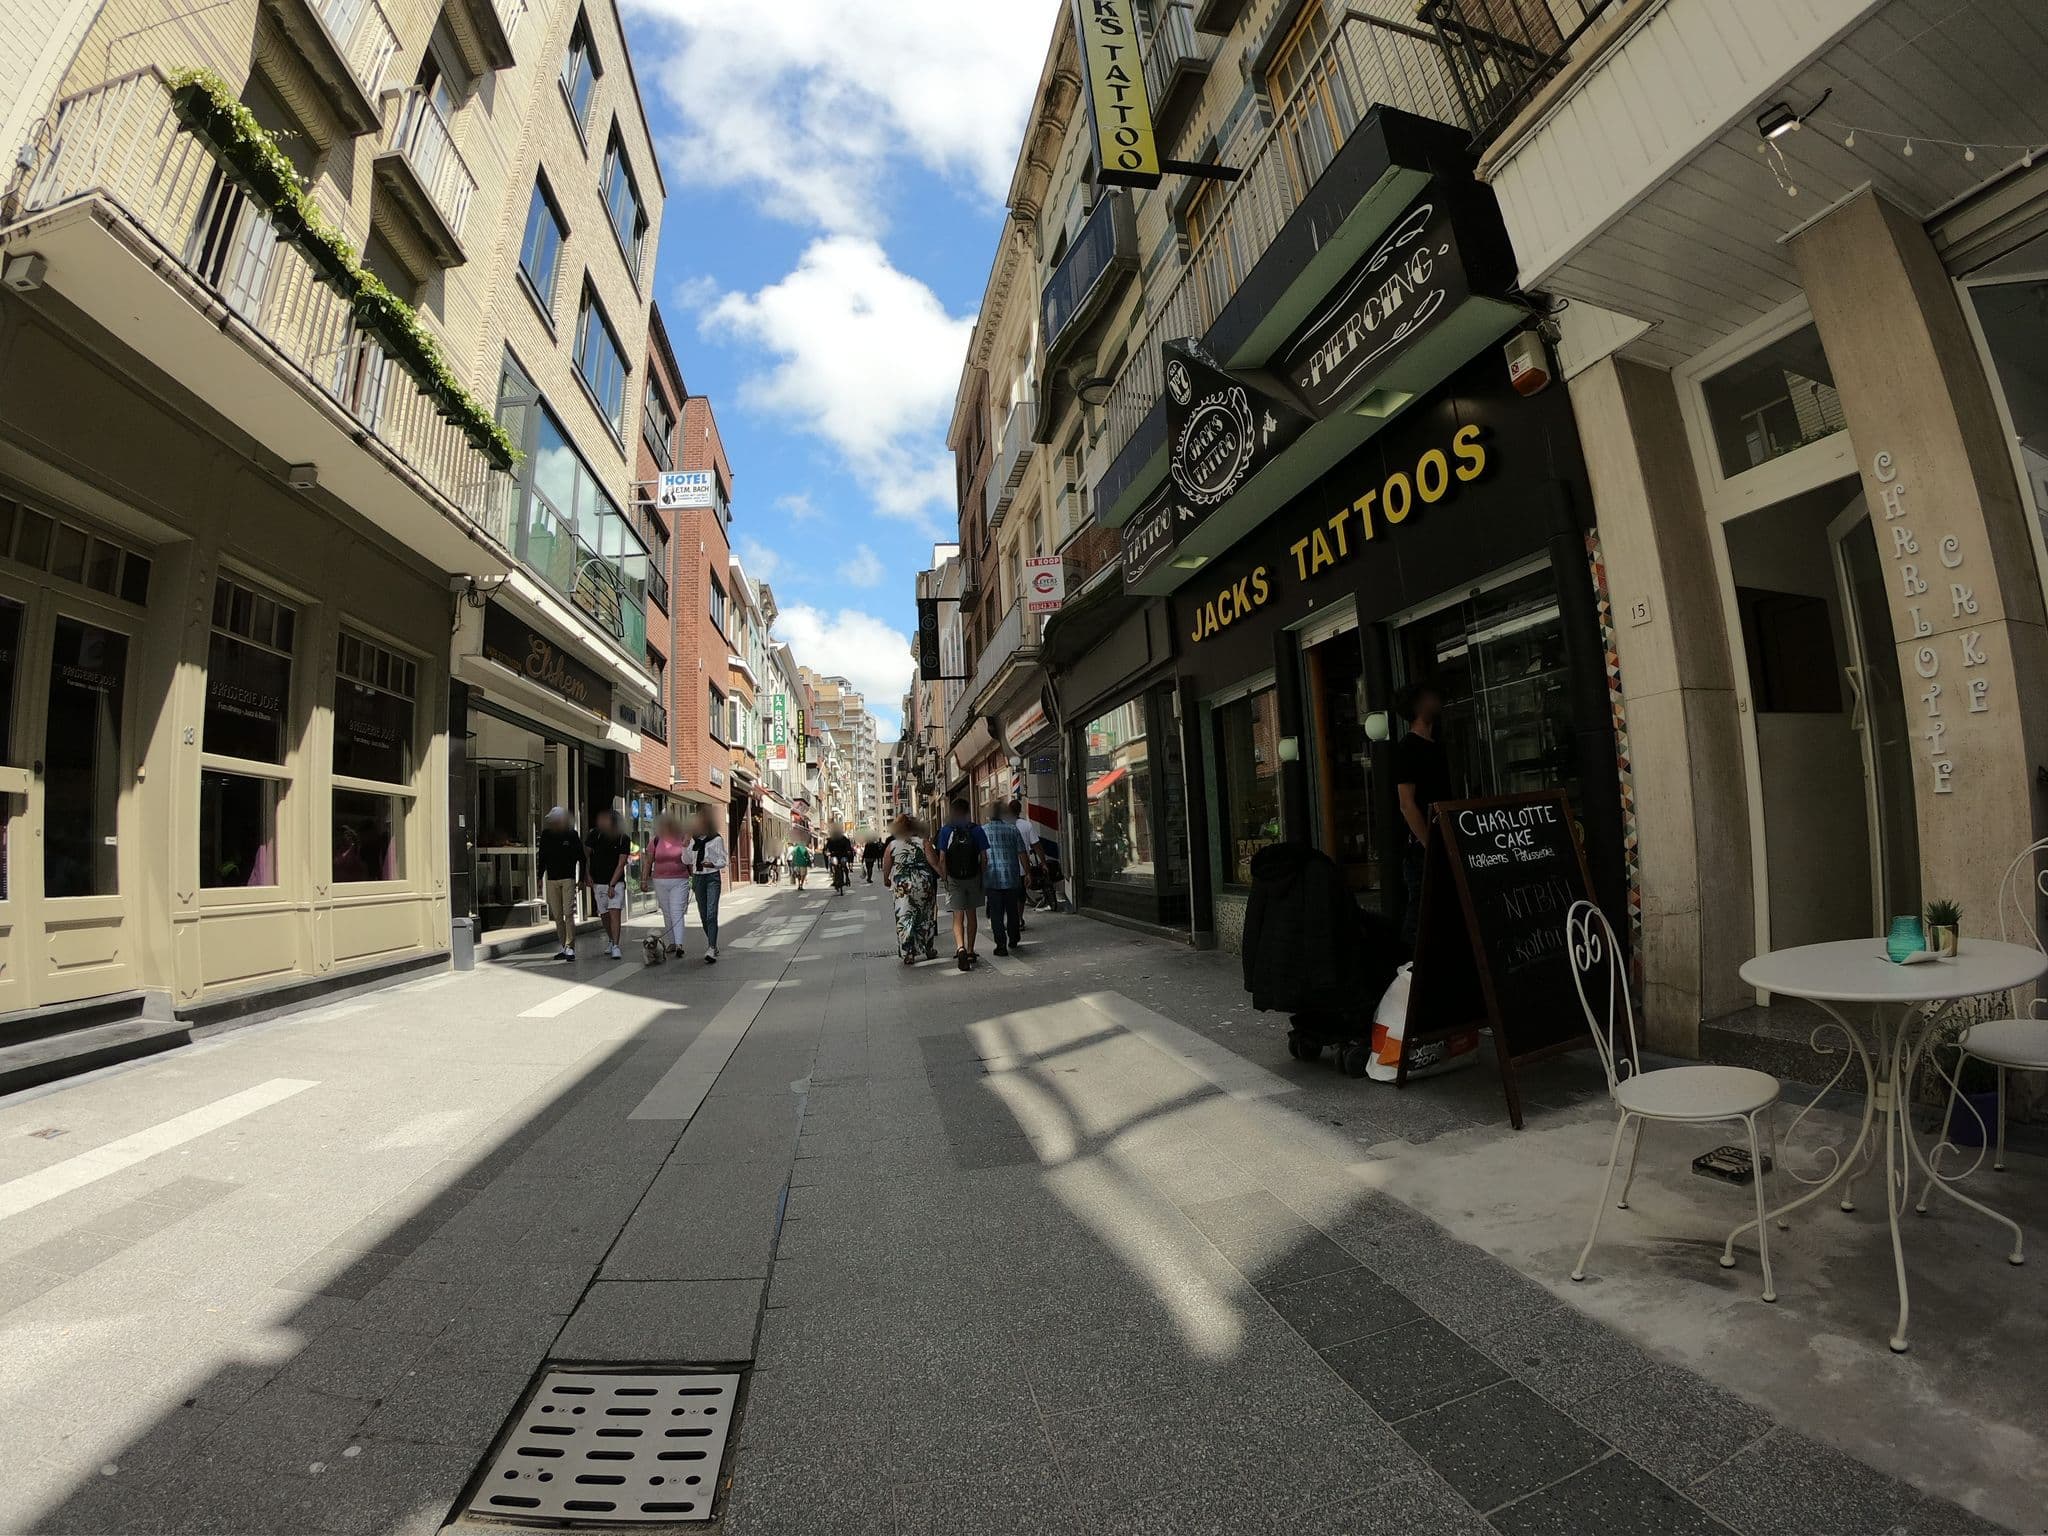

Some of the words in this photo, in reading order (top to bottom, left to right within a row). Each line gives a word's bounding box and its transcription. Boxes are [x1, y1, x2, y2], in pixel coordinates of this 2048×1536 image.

[1100, 45, 1142, 169] TATTOO
[1309, 248, 1433, 387] PIERCING
[1189, 414, 1223, 460] JACK'S
[1193, 432, 1237, 485] TATTOO
[665, 474, 707, 486] HOTEL
[692, 485, 709, 493] BACH
[1127, 507, 1171, 564] TATTOO
[1192, 566, 1268, 642] JACKS
[1290, 424, 1486, 582] TATTOOS
[1038, 557, 1060, 565] KOOP
[1631, 603, 1646, 620] 15
[1873, 451, 1954, 794] CHARLOTTE
[1939, 534, 1989, 713] CAKE
[776, 695, 782, 707] LA
[184, 726, 194, 746] 18
[775, 709, 783, 741] ROMANA
[1459, 805, 1557, 836] CHARLOTTE
[1494, 828, 1535, 849] CAKE
